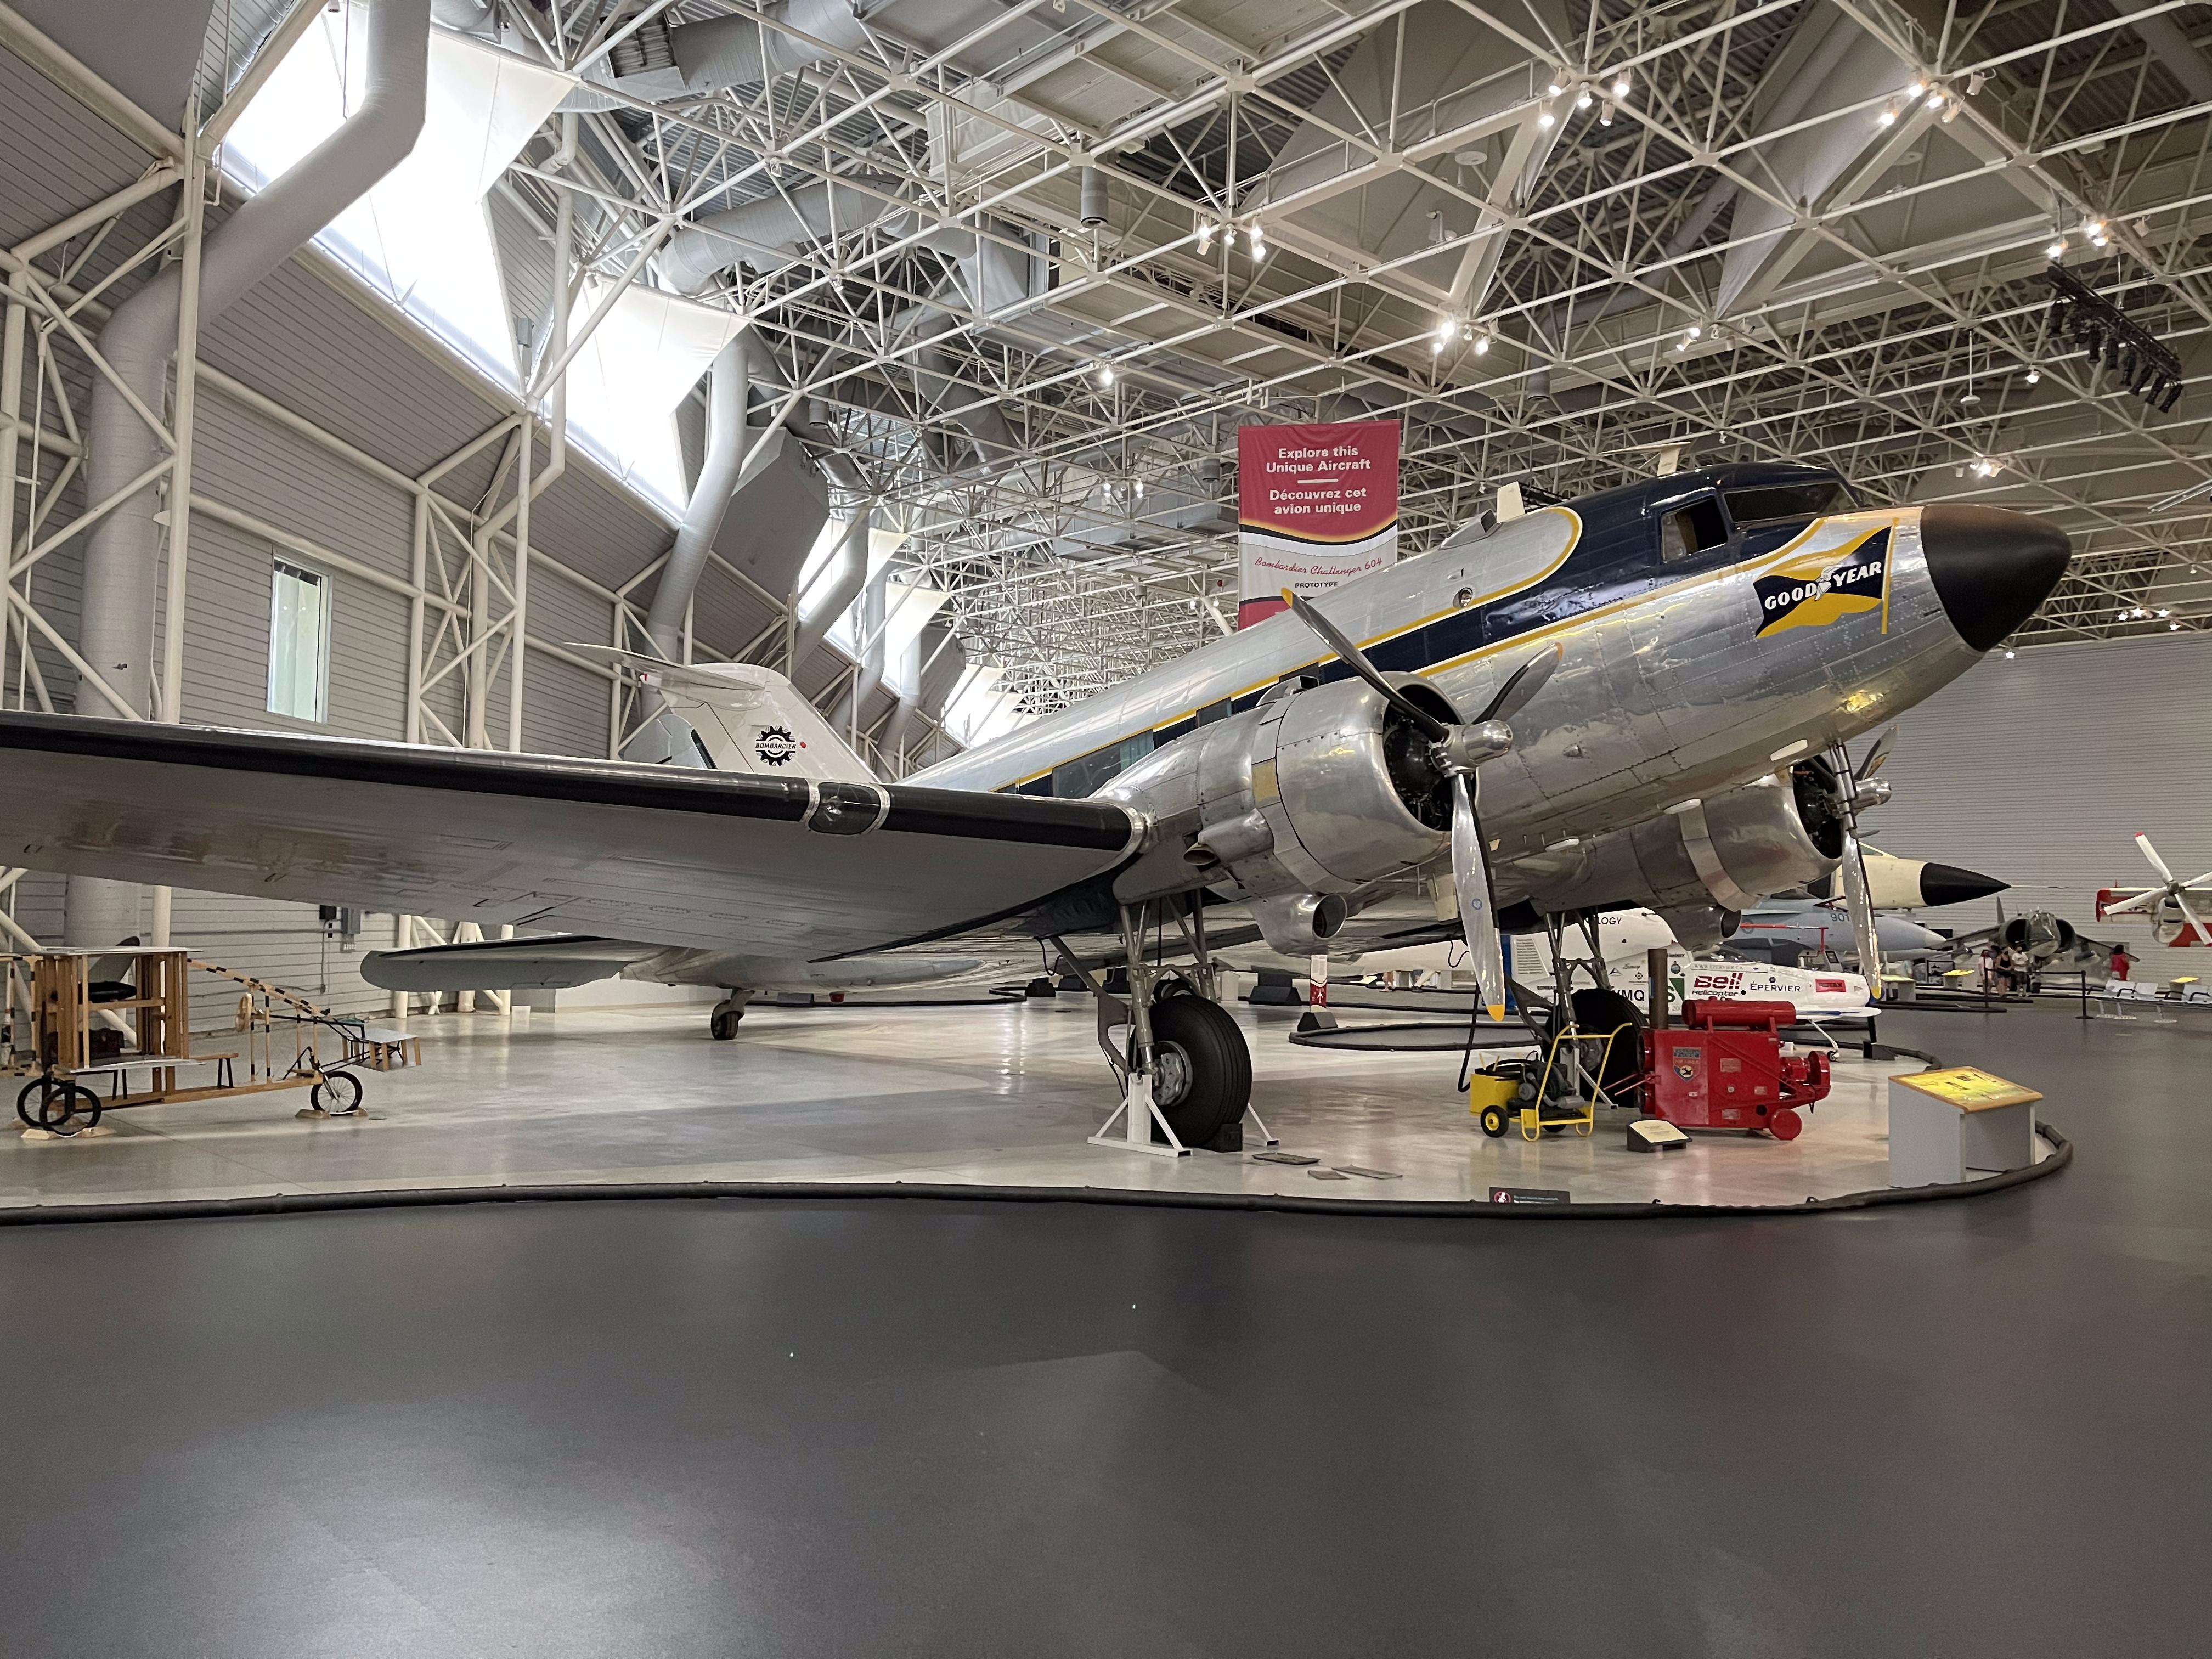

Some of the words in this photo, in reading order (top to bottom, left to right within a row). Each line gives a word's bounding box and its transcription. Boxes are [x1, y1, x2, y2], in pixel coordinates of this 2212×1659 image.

[1278, 447, 1329, 460] Explore
[1333, 445, 1358, 456] this
[1266, 462, 1313, 474] Unique
[1317, 459, 1370, 471] Aircraft
[1269, 489, 1341, 500] Découvrez
[1345, 488, 1367, 497] cet
[1274, 503, 1311, 514] avion
[1315, 502, 1361, 514] unique
[1255, 557, 1307, 573] Bombardier
[1310, 566, 1362, 577] Challenger
[1364, 557, 1383, 570] 604
[1830, 912, 1850, 922] 901
[1750, 981, 1801, 992] ÉPERVIER
[1692, 989, 1739, 997] Helicopter
